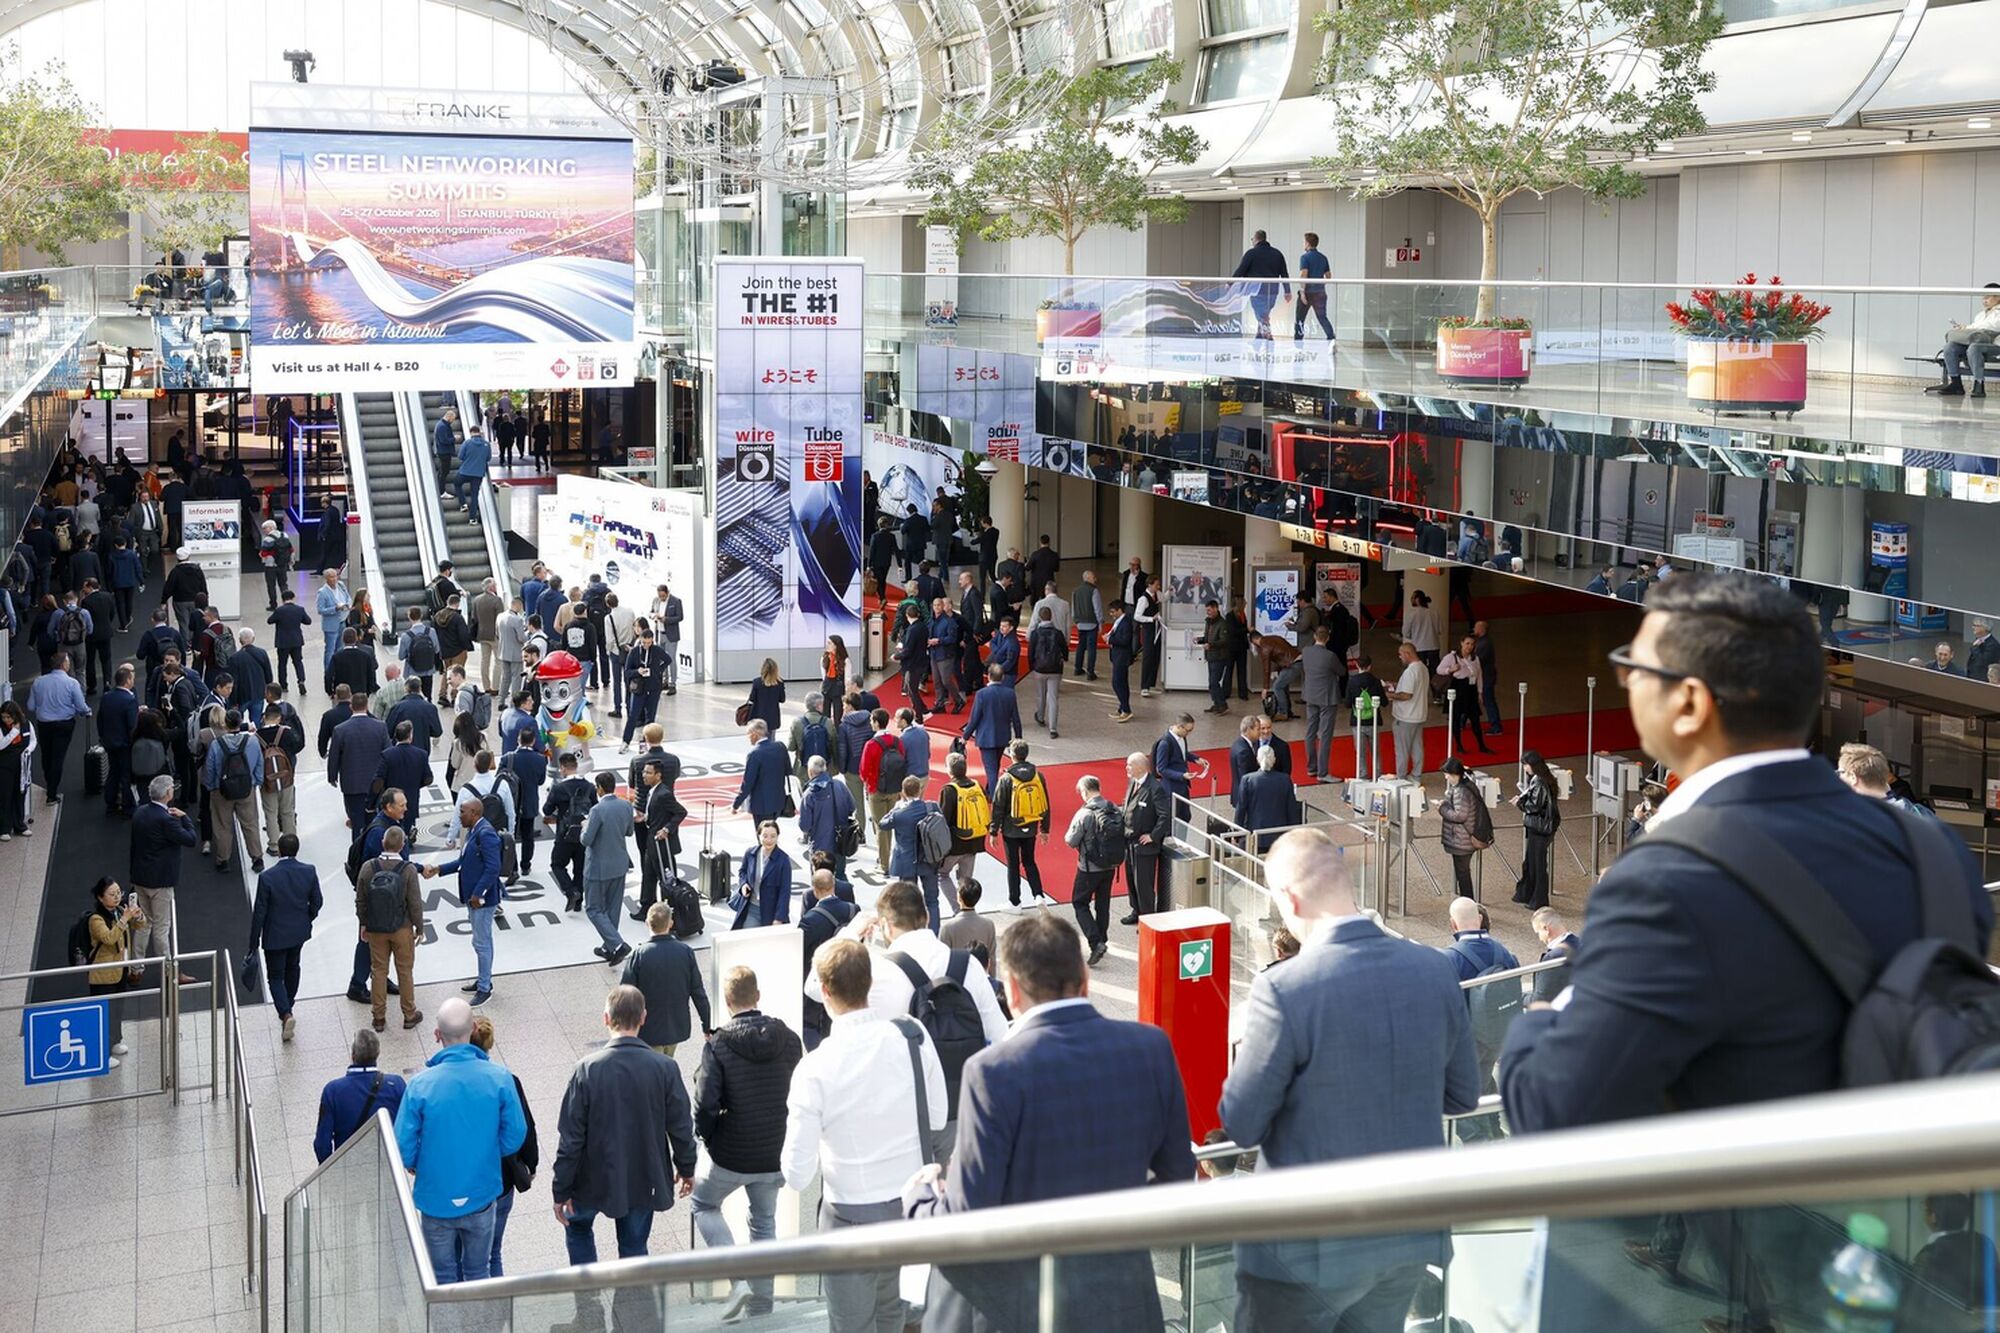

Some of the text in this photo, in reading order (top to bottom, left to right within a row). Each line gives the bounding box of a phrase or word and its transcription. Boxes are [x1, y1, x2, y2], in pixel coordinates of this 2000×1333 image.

[416, 103, 511, 119] FRANKE
[313, 153, 577, 177] STEEL NETWORKING
[389, 181, 508, 201] SUMMITS
[340, 207, 353, 217] 25
[360, 207, 374, 217] 27
[374, 207, 414, 218] October
[416, 207, 441, 218] 2026
[369, 224, 526, 236] www.networkingsummits.com
[742, 276, 837, 290] Join the best
[741, 293, 838, 313] THE #1
[741, 316, 837, 325] IN WIRES&TUBES
[272, 320, 448, 340] Let's Meet in Istanbul
[272, 361, 303, 373] Visit
[307, 364, 323, 373] us
[326, 362, 340, 373] at
[344, 362, 370, 372] Hall
[373, 362, 383, 372] 4
[394, 361, 420, 372] B20
[761, 368, 818, 384] ようこそ
[735, 427, 775, 442] wire
[803, 426, 843, 442] Tube
[1265, 602, 1292, 610] TIALS
